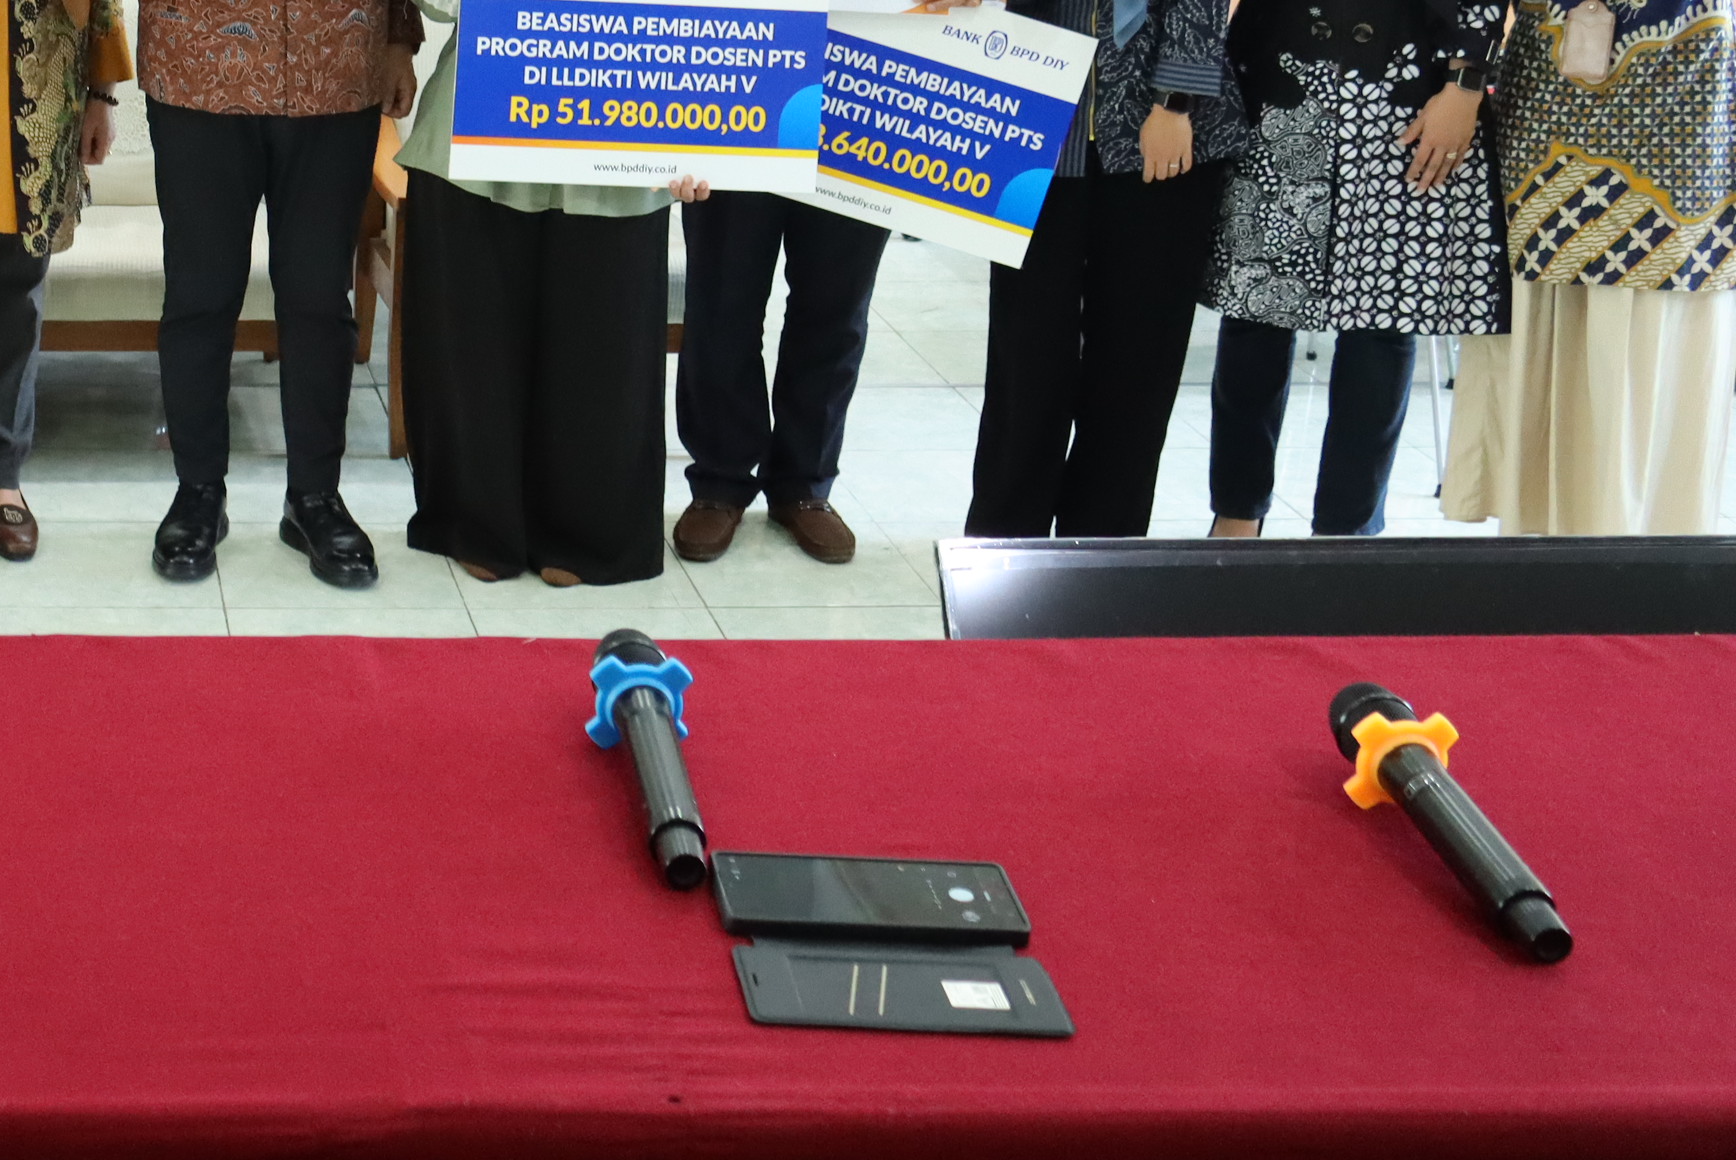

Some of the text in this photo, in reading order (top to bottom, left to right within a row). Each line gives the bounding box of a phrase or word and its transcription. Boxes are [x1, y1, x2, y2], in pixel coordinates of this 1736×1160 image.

[517, 11, 774, 41] BEASISWA PEMBIAYAAN
[477, 37, 805, 69] PROGRAM DOKTOR DOSEN PTS
[942, 25, 1069, 70] BANK BPD DIY
[524, 66, 757, 93] DI LLDIKTI WILAYAH V
[824, 43, 877, 74] ISWA
[881, 60, 1020, 116] PEMBIAYAAN
[510, 96, 766, 135] Rp 51.980.000,00
[821, 94, 991, 160] DIKTI WILAYAH V
[838, 73, 926, 116] DOKTOR
[930, 102, 1003, 138] DOSEN
[1004, 124, 1044, 150] PTS
[594, 163, 677, 175] www.bpddiy.co.id
